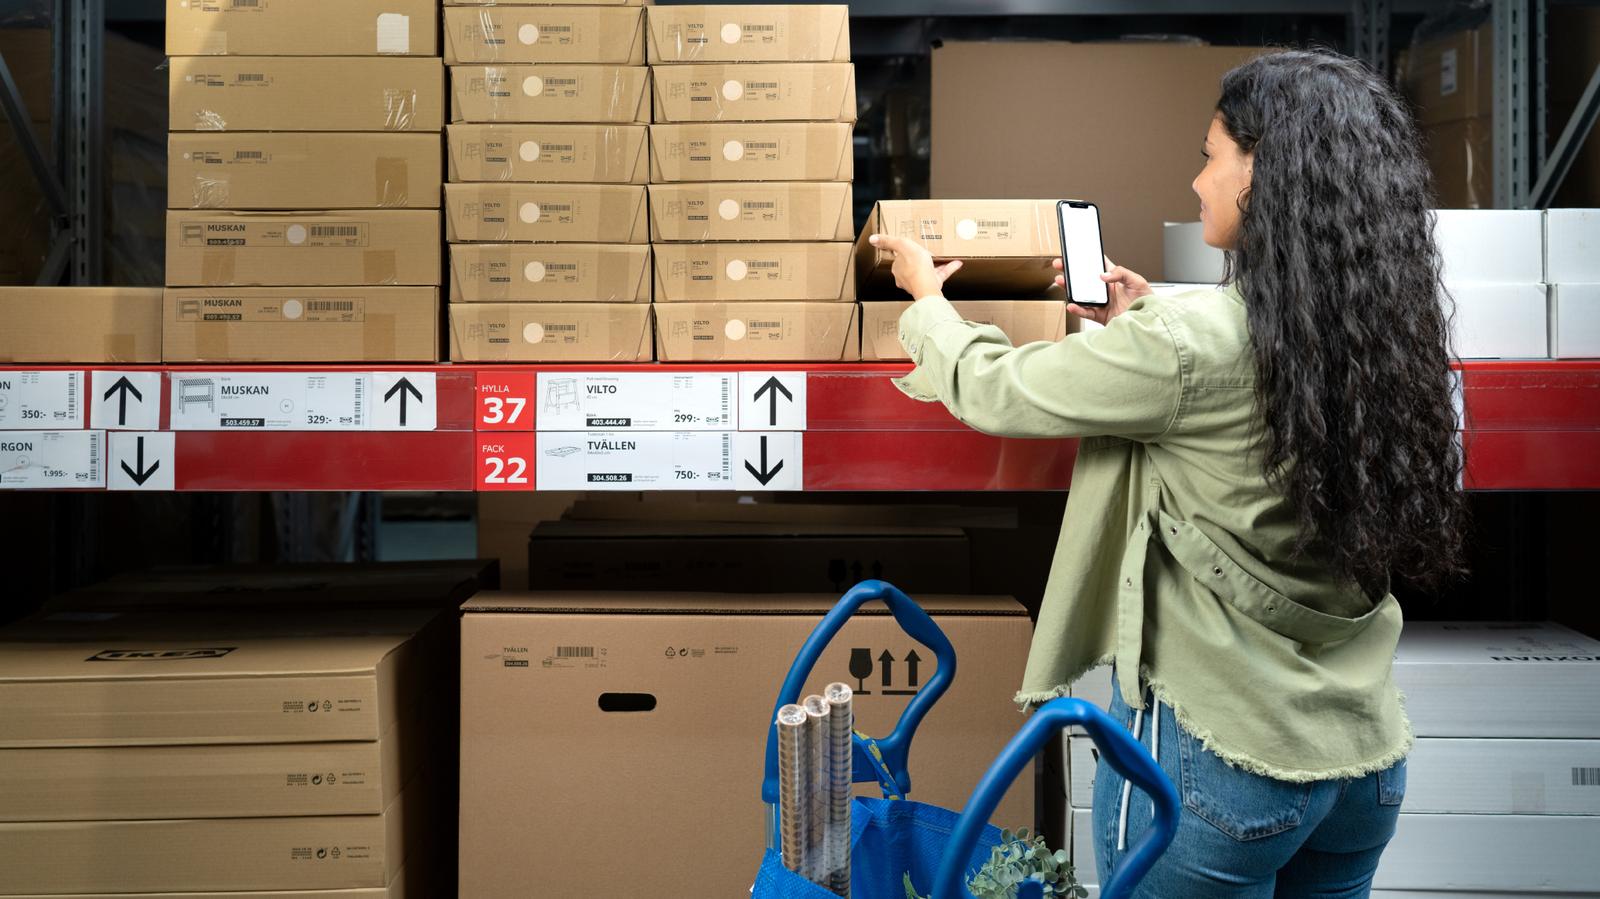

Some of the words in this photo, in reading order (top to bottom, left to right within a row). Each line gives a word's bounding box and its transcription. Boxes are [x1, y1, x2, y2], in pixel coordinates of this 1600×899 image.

[207, 224, 246, 232] MUSKAN
[204, 299, 242, 307] MUSKAN
[0, 381, 11, 390] N
[221, 385, 269, 395] MUSKAN
[482, 384, 509, 393] HYLLA
[586, 385, 617, 394] VILTO
[21, 409, 47, 419] 350:-
[483, 397, 527, 424] 37
[307, 415, 332, 424] 329:-
[674, 414, 700, 423] 299:-
[482, 444, 505, 453] FACK
[587, 438, 636, 450] TVÄLLEN
[43, 470, 68, 478] 1.995:-
[484, 457, 528, 484] 22
[674, 470, 700, 479] 750:-
